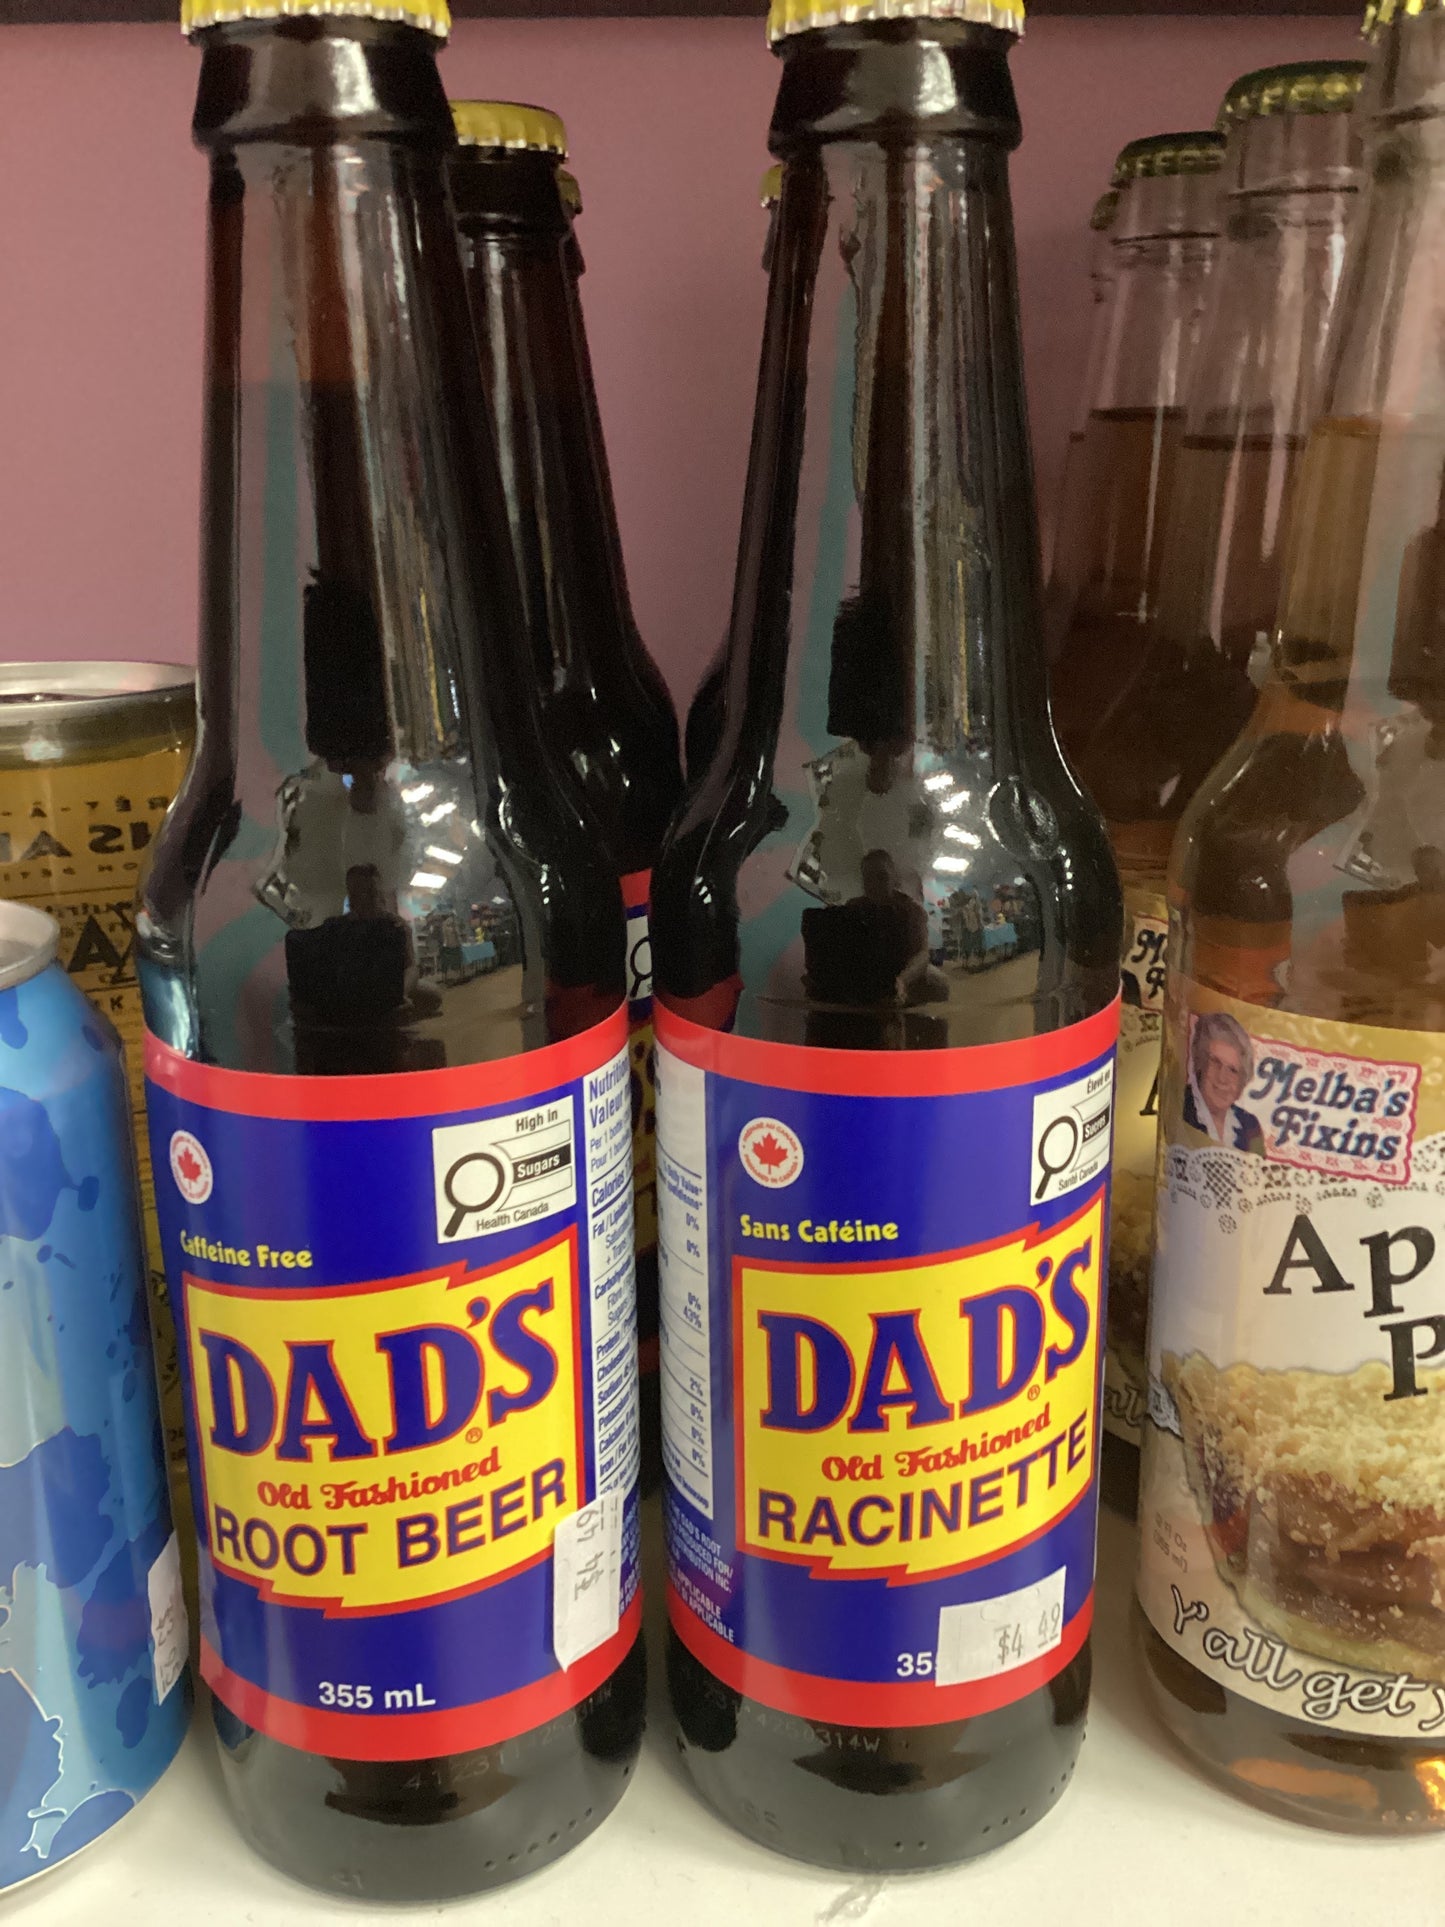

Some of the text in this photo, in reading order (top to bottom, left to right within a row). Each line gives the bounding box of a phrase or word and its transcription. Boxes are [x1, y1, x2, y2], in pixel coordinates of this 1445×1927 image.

[1249, 1055, 1410, 1120] Melba's
[516, 1109, 558, 1132] High in
[1270, 1105, 1400, 1163] Fixins
[517, 1154, 560, 1178] Sugars
[476, 1202, 549, 1232] Health Canada
[740, 1213, 899, 1244] Sans Caféine
[180, 1229, 313, 1268] Caffeine Free
[1262, 1214, 1445, 1319] Ap
[757, 1234, 1093, 1434] DAD'S
[199, 1275, 559, 1462] DAD'S
[821, 1456, 884, 1482] Old
[895, 1403, 1050, 1478] Fashioned
[258, 1446, 502, 1510] Old Fashioned
[757, 1408, 1088, 1547] RACINETTE
[214, 1502, 367, 1577] ROOT
[396, 1457, 567, 1570] BEER
[896, 1651, 938, 1677] 35
[318, 1681, 436, 1710] 355 mL
[1302, 1670, 1427, 1721] get
